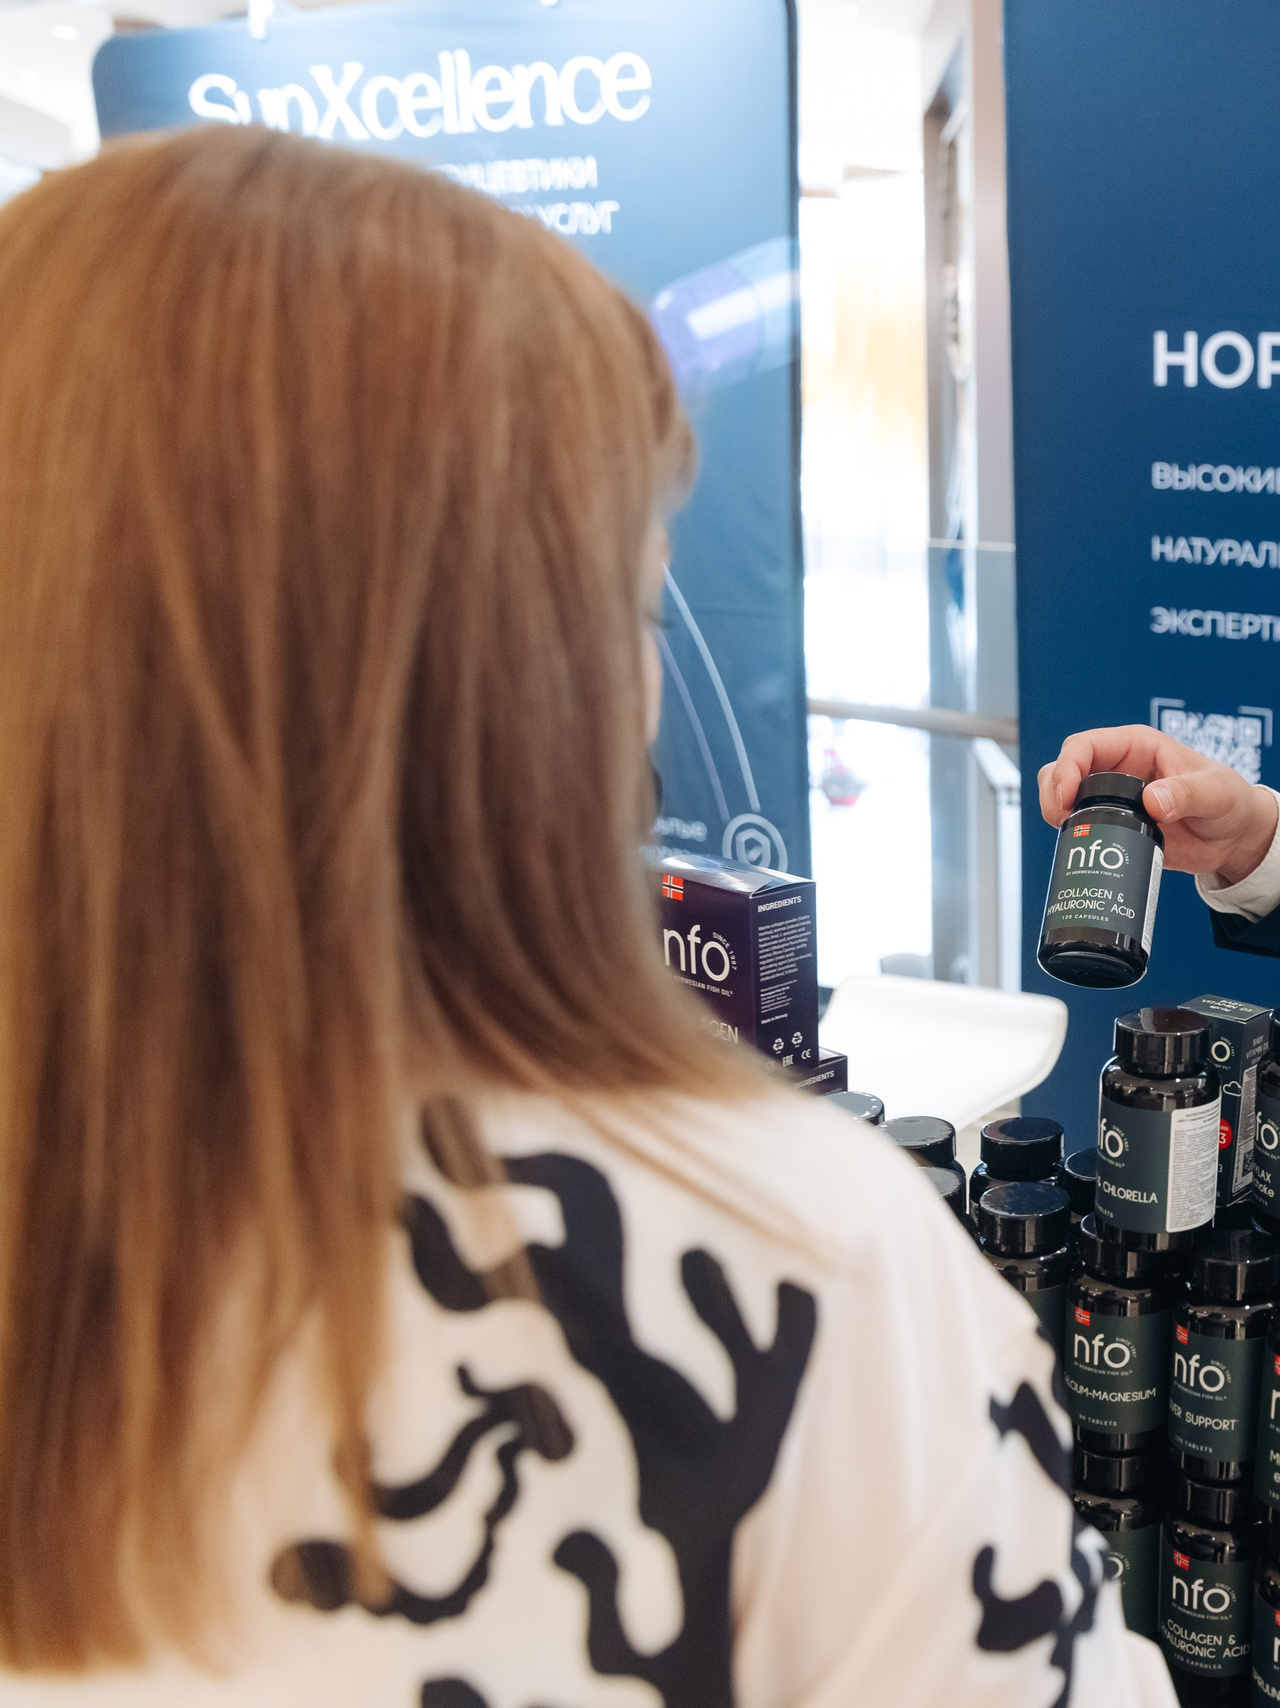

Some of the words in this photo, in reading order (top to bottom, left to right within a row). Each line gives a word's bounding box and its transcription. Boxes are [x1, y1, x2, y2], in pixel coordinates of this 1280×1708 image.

[1066, 839, 1124, 870] nfo
[757, 895, 803, 913] INGREDIENTS
[1057, 887, 1113, 900] COLLAGEN
[1116, 893, 1125, 903] &
[1046, 899, 1106, 917] HYALURONIC
[1110, 903, 1136, 919] ACID
[1074, 914, 1109, 922] CAPSULES
[712, 931, 731, 950] SINCE
[662, 924, 731, 983] nfo
[674, 976, 706, 991] ORWEGIAN
[706, 984, 721, 995] FISH
[1102, 1180, 1159, 1204] CHLORELLA
[1073, 1333, 1131, 1369] nfo
[1174, 1352, 1225, 1393] nfo
[1065, 1373, 1156, 1402] ALCIUM-MAGNESIUM
[1087, 1417, 1118, 1427] TABLETS
[1185, 1411, 1237, 1431] SUPPORT
[1185, 1440, 1213, 1453] TABLETS
[1172, 1575, 1230, 1614] nfo
[1167, 1618, 1223, 1646] COLLAGEN
[1227, 1634, 1237, 1645] &
[1222, 1643, 1251, 1659] ACID
[1185, 1658, 1222, 1670] CAPSULES
